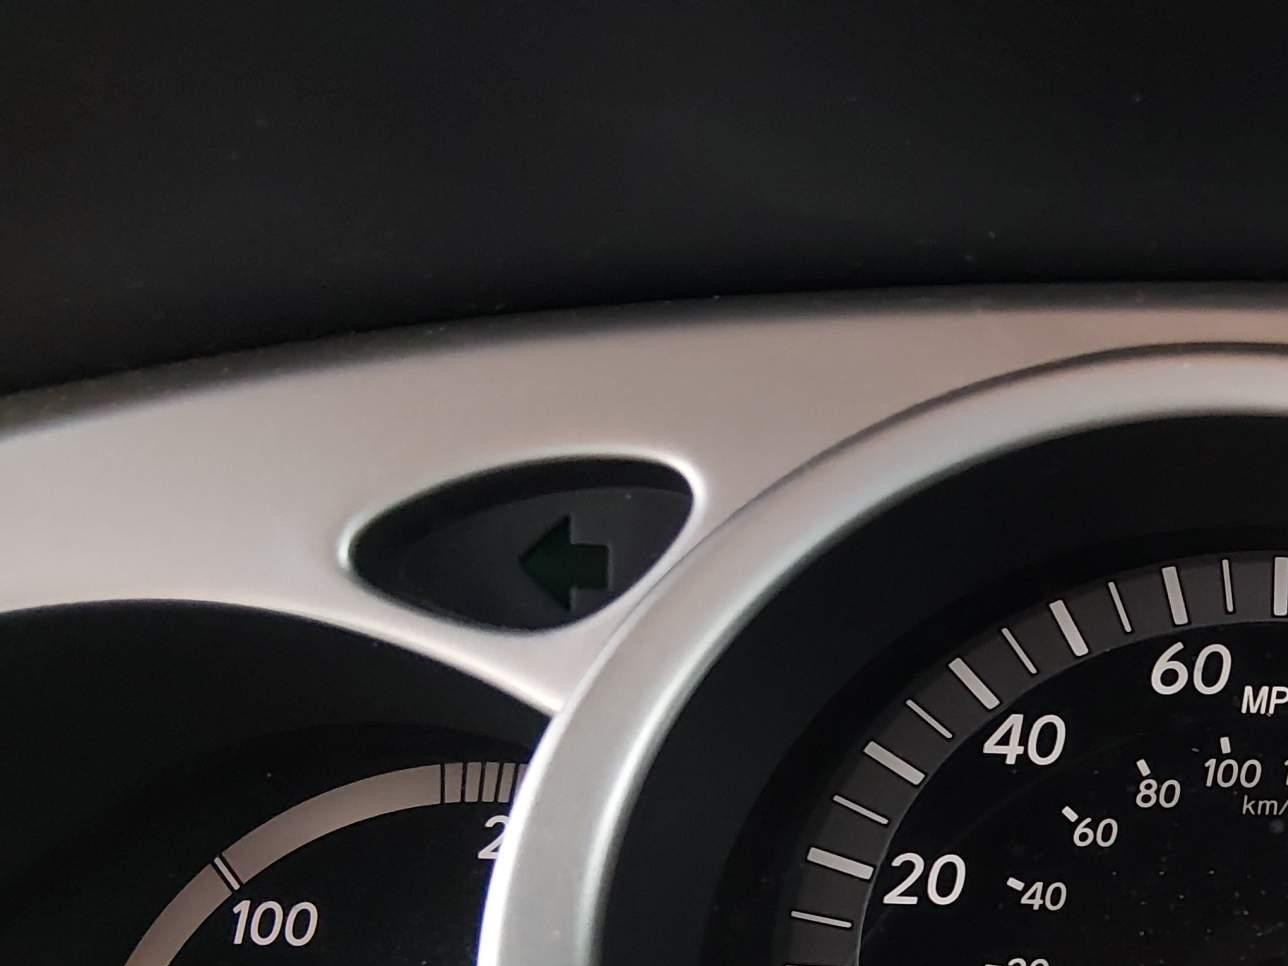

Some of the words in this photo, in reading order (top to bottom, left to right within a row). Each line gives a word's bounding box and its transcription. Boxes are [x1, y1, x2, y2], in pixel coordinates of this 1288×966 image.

[1151, 642, 1231, 694] 60
[983, 714, 1065, 765] 40
[1205, 759, 1261, 787] 100
[1136, 779, 1180, 808] 80
[1073, 818, 1118, 848] 60
[884, 853, 965, 905] 20
[1021, 881, 1066, 910] 40
[233, 900, 317, 946] 100
